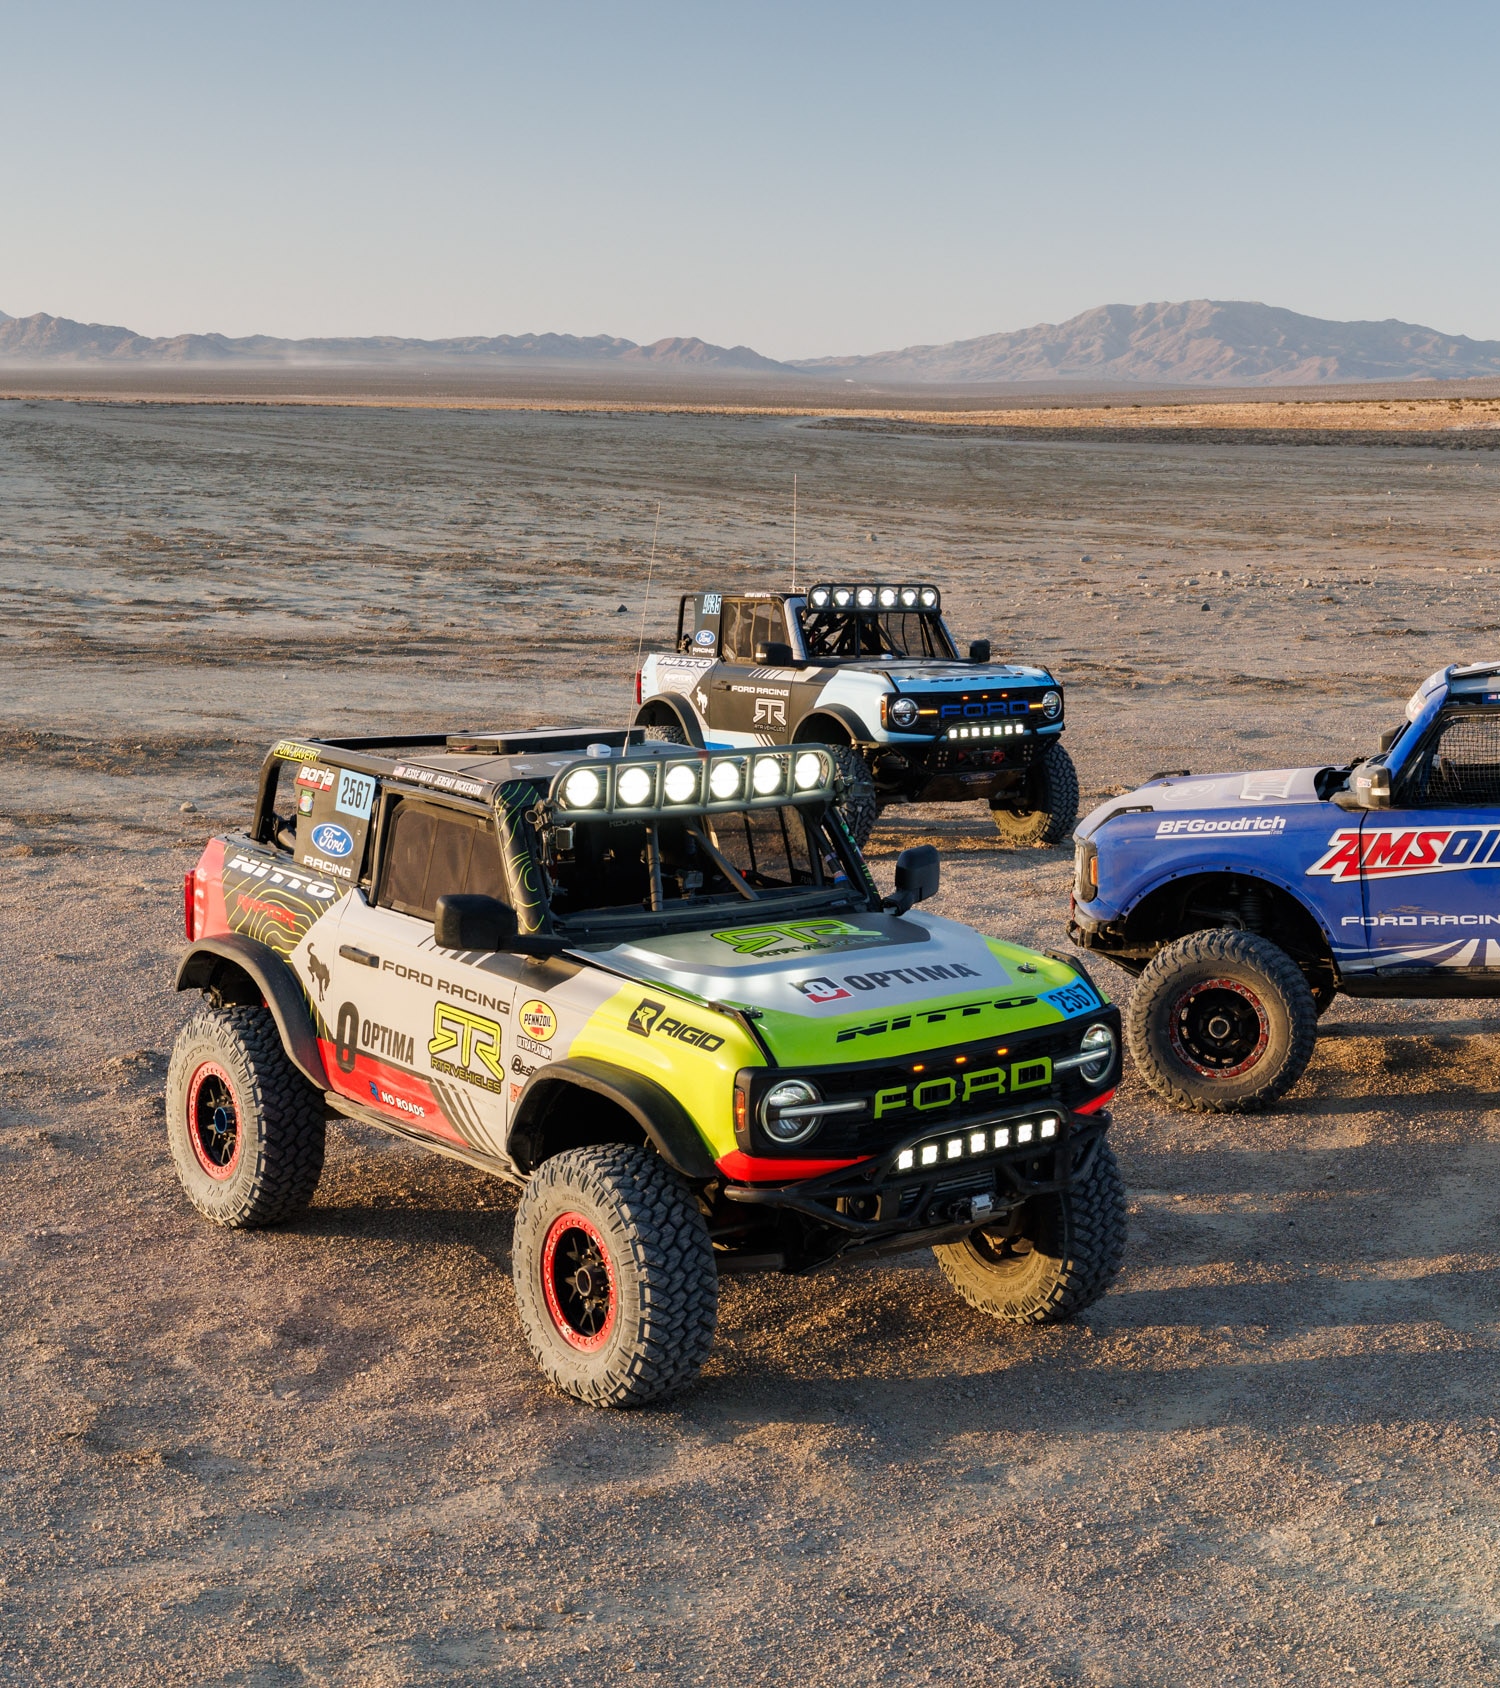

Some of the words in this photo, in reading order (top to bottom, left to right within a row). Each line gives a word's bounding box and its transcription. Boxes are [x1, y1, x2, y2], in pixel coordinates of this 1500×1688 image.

[657, 656, 713, 668] NITTO
[731, 685, 755, 694] FORD
[756, 687, 790, 697] RACING
[940, 700, 1029, 719] FORD
[341, 777, 372, 810] 2567
[403, 767, 421, 780] JESSE
[434, 774, 457, 789] JEREMY
[453, 779, 484, 796] DICKENSON
[1156, 815, 1287, 834] BFGoodrich
[318, 826, 346, 854] Ford
[227, 854, 336, 899] NITTO
[303, 855, 352, 878] RACING
[1341, 915, 1417, 926] FORD
[382, 959, 433, 988] FORD
[437, 978, 511, 1015] RACING
[843, 962, 983, 992] OPTIMA
[1049, 983, 1098, 1015] 2567
[523, 1013, 552, 1028] PENNZOIL
[835, 995, 1043, 1043] NITTO
[361, 1019, 415, 1065] OPTIMA
[517, 1036, 531, 1053] ULTRA
[530, 1040, 552, 1060] PLATINUM
[656, 1018, 726, 1053] RIGID
[431, 1057, 451, 1075] RTR
[450, 1064, 501, 1094] VEHICLES
[873, 1056, 1053, 1119] FORD
[381, 1091, 395, 1106] NO
[396, 1097, 425, 1118] ROADS
